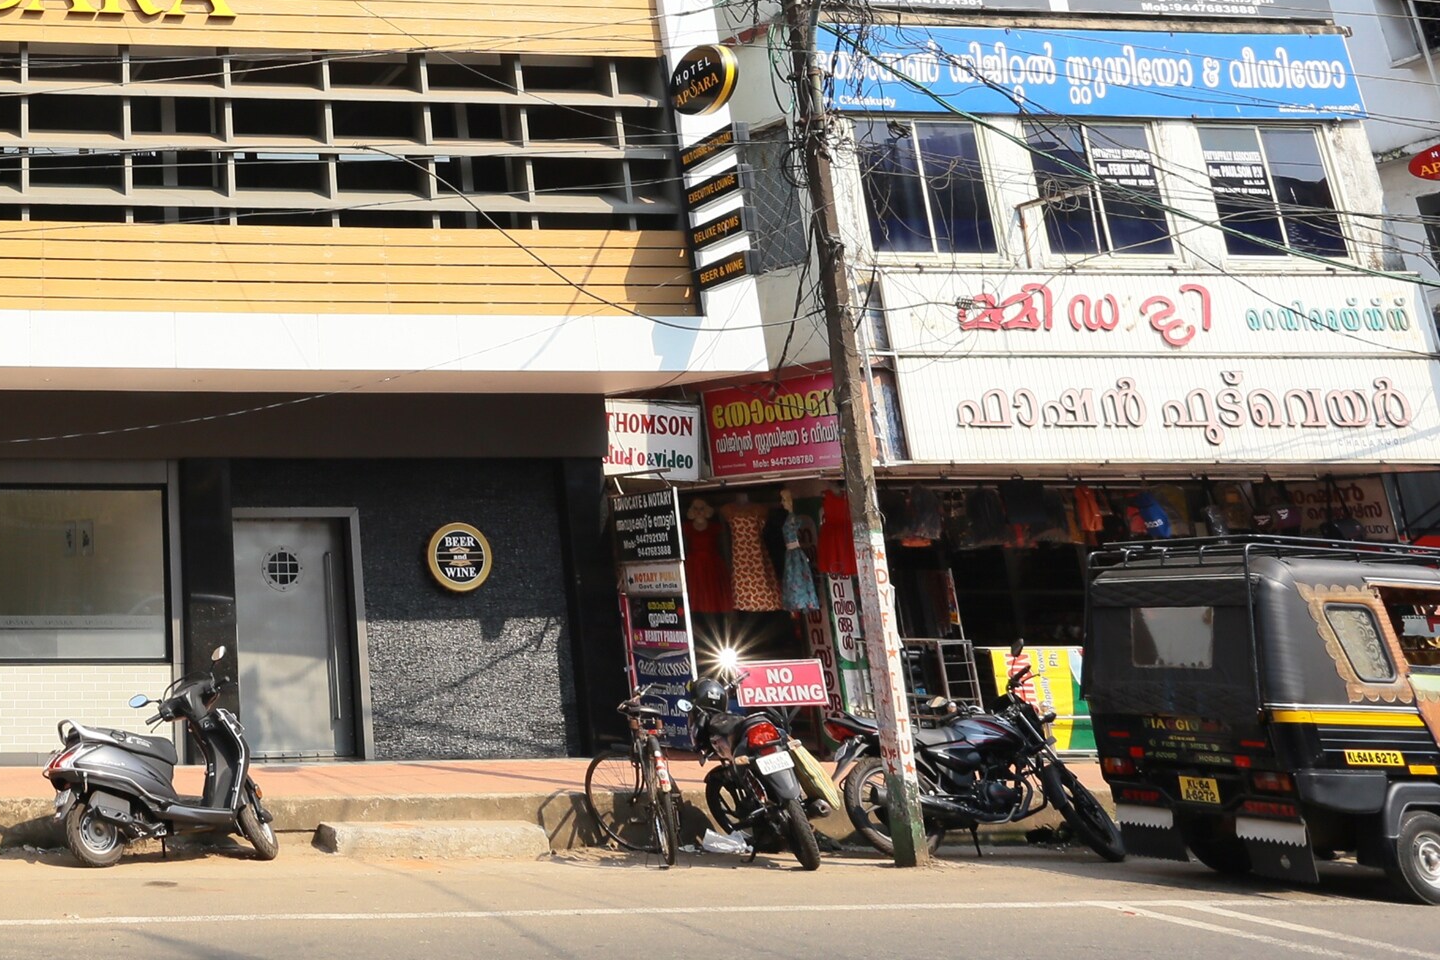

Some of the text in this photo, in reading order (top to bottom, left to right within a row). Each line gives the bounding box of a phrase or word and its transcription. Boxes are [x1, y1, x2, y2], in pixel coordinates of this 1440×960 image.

[675, 56, 711, 86] HOTEL
[1202, 56, 1220, 89] &
[676, 72, 719, 107] APSARA
[688, 174, 736, 204] EXECUTIVE LOUNGE
[694, 215, 740, 243] DELUXE ROOMS
[700, 258, 744, 283] BEER & WINE
[957, 376, 1147, 428] ഫാഷൻ
[604, 412, 693, 436] THOMSON
[801, 426, 808, 444] &
[752, 460, 770, 469] Mob:
[613, 495, 643, 511] ADVOCATE
[647, 490, 672, 508] NOTARY
[445, 536, 475, 547] BEER
[445, 567, 477, 578] WINE
[633, 572, 657, 583] NOTARY
[662, 581, 678, 589] India
[766, 668, 793, 684] NO
[743, 684, 824, 703] PARKING
